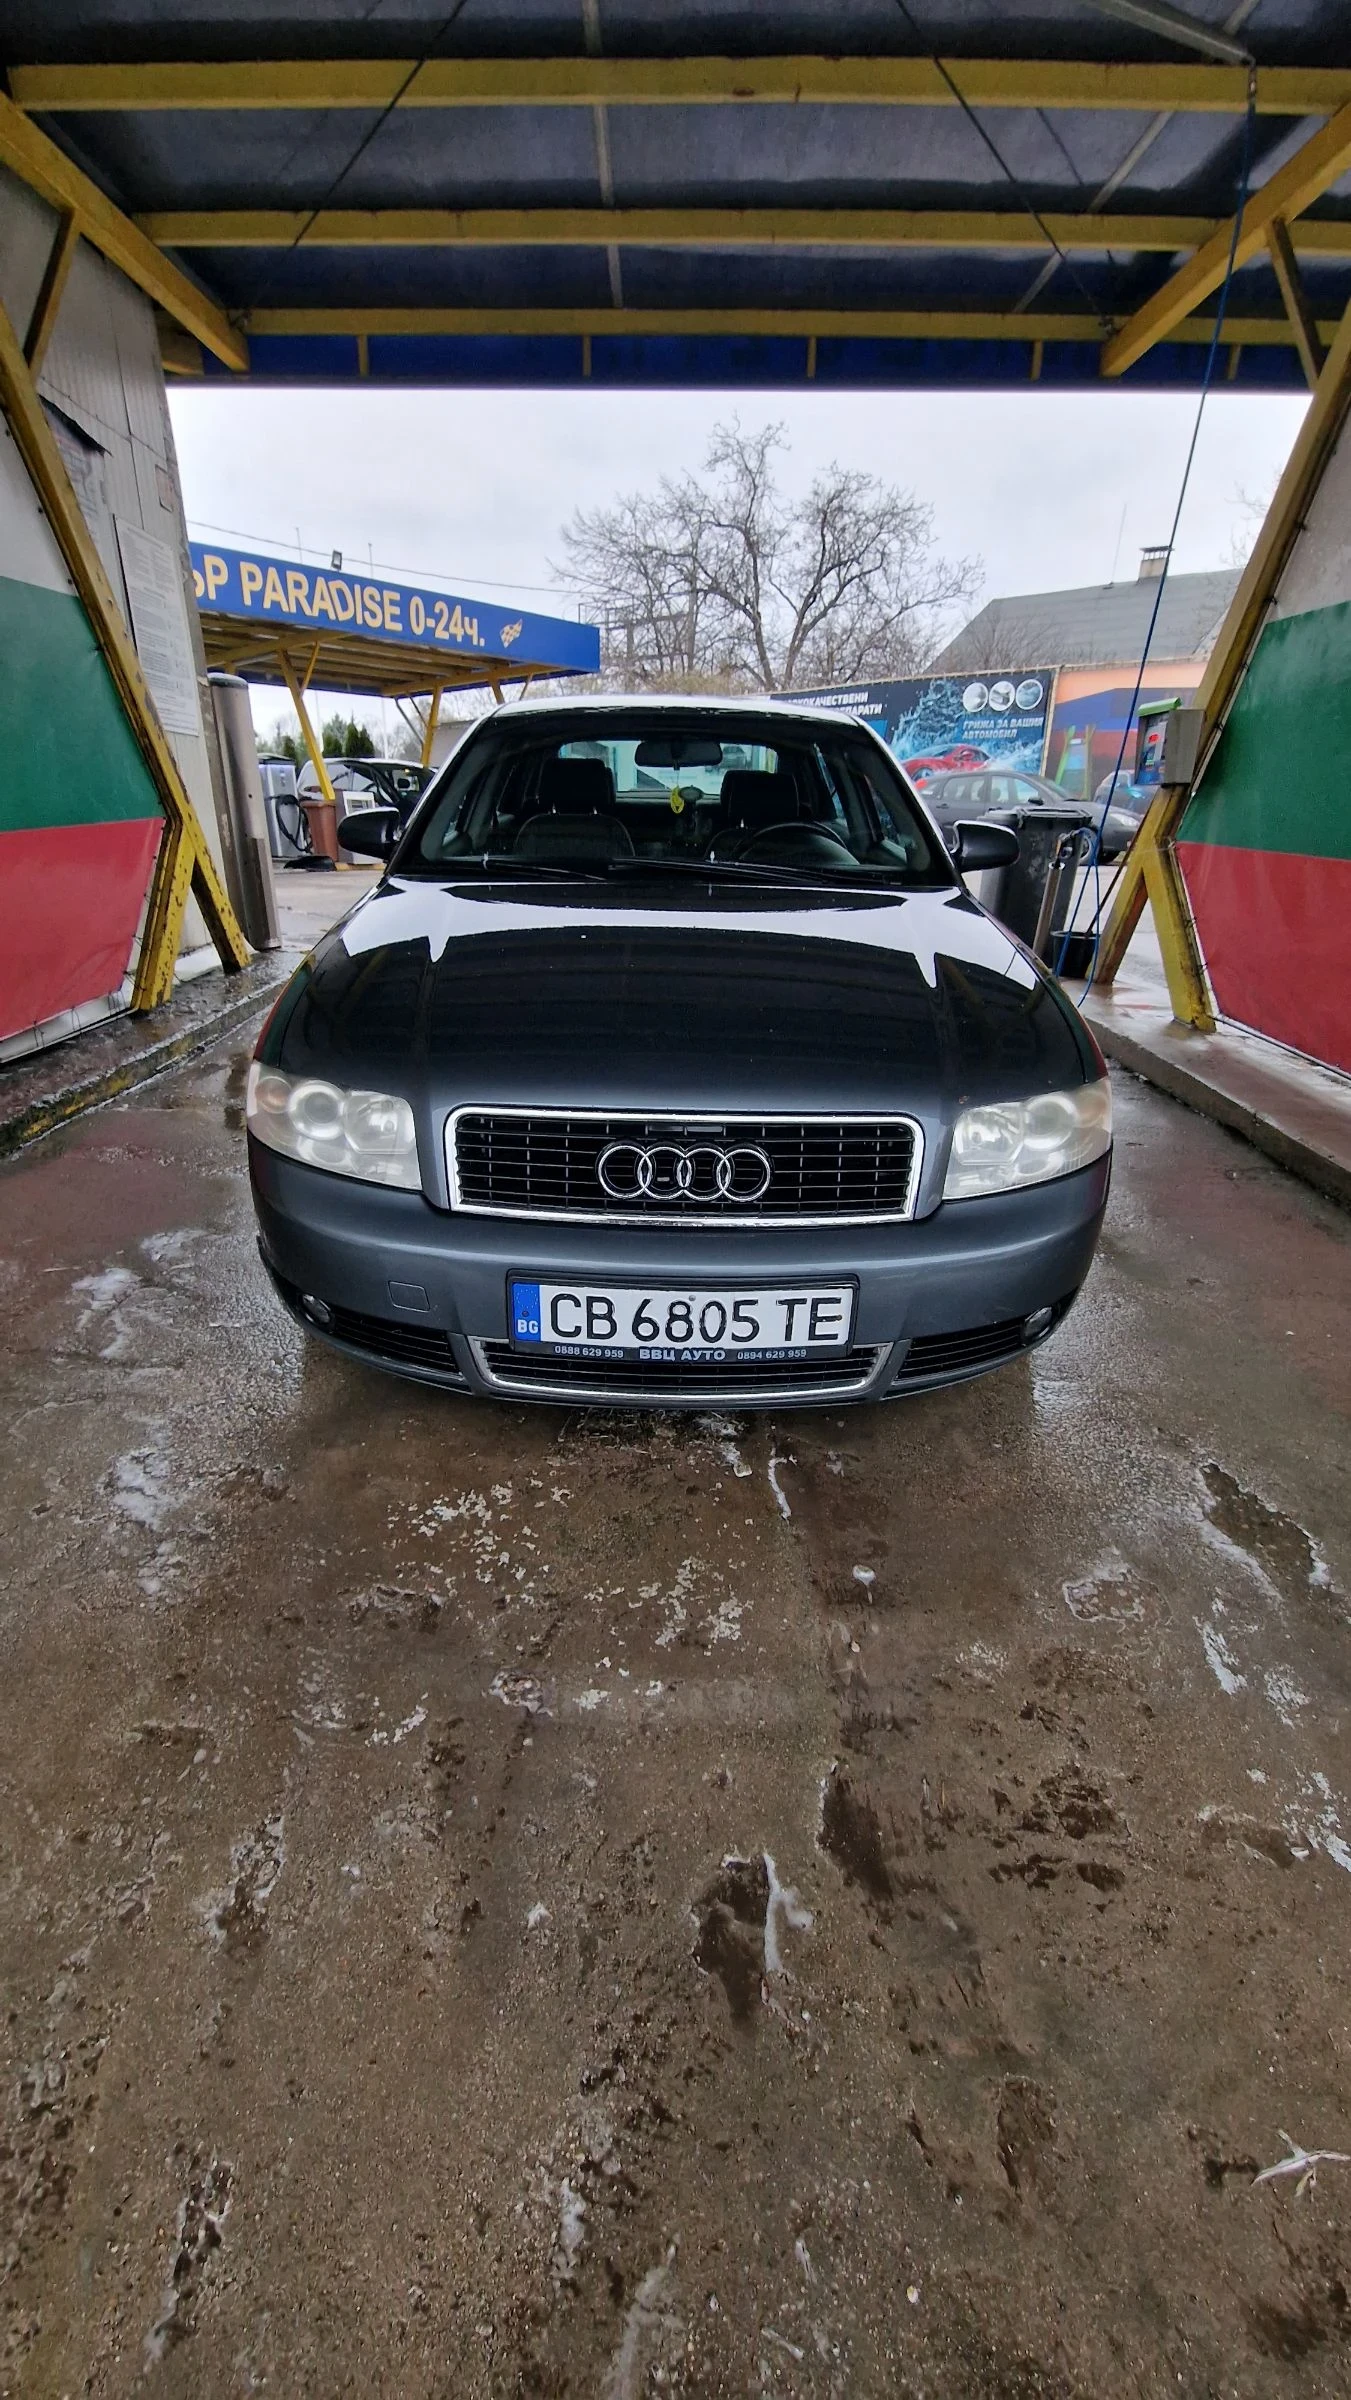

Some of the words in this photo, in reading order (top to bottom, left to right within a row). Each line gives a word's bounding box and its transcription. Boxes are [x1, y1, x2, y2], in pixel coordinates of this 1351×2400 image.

[239, 561, 402, 632] PARADISE
[409, 595, 485, 647] 0-24ч.
[963, 719, 995, 730] ГРИЖА
[997, 718, 1008, 729] ЗА
[962, 729, 1018, 739] АВТОМОБИЛ
[517, 1319, 539, 1334] BG
[631, 1298, 760, 1343] 6805
[775, 1297, 843, 1341] TE
[554, 1345, 580, 1356] 0888
[582, 1347, 602, 1357] 629
[604, 1349, 624, 1358] 959
[639, 1348, 676, 1362] ВВЦ
[681, 1349, 726, 1361] АУТО
[737, 1351, 763, 1360] 0894
[765, 1350, 785, 1359] 629
[787, 1349, 807, 1358] 959
